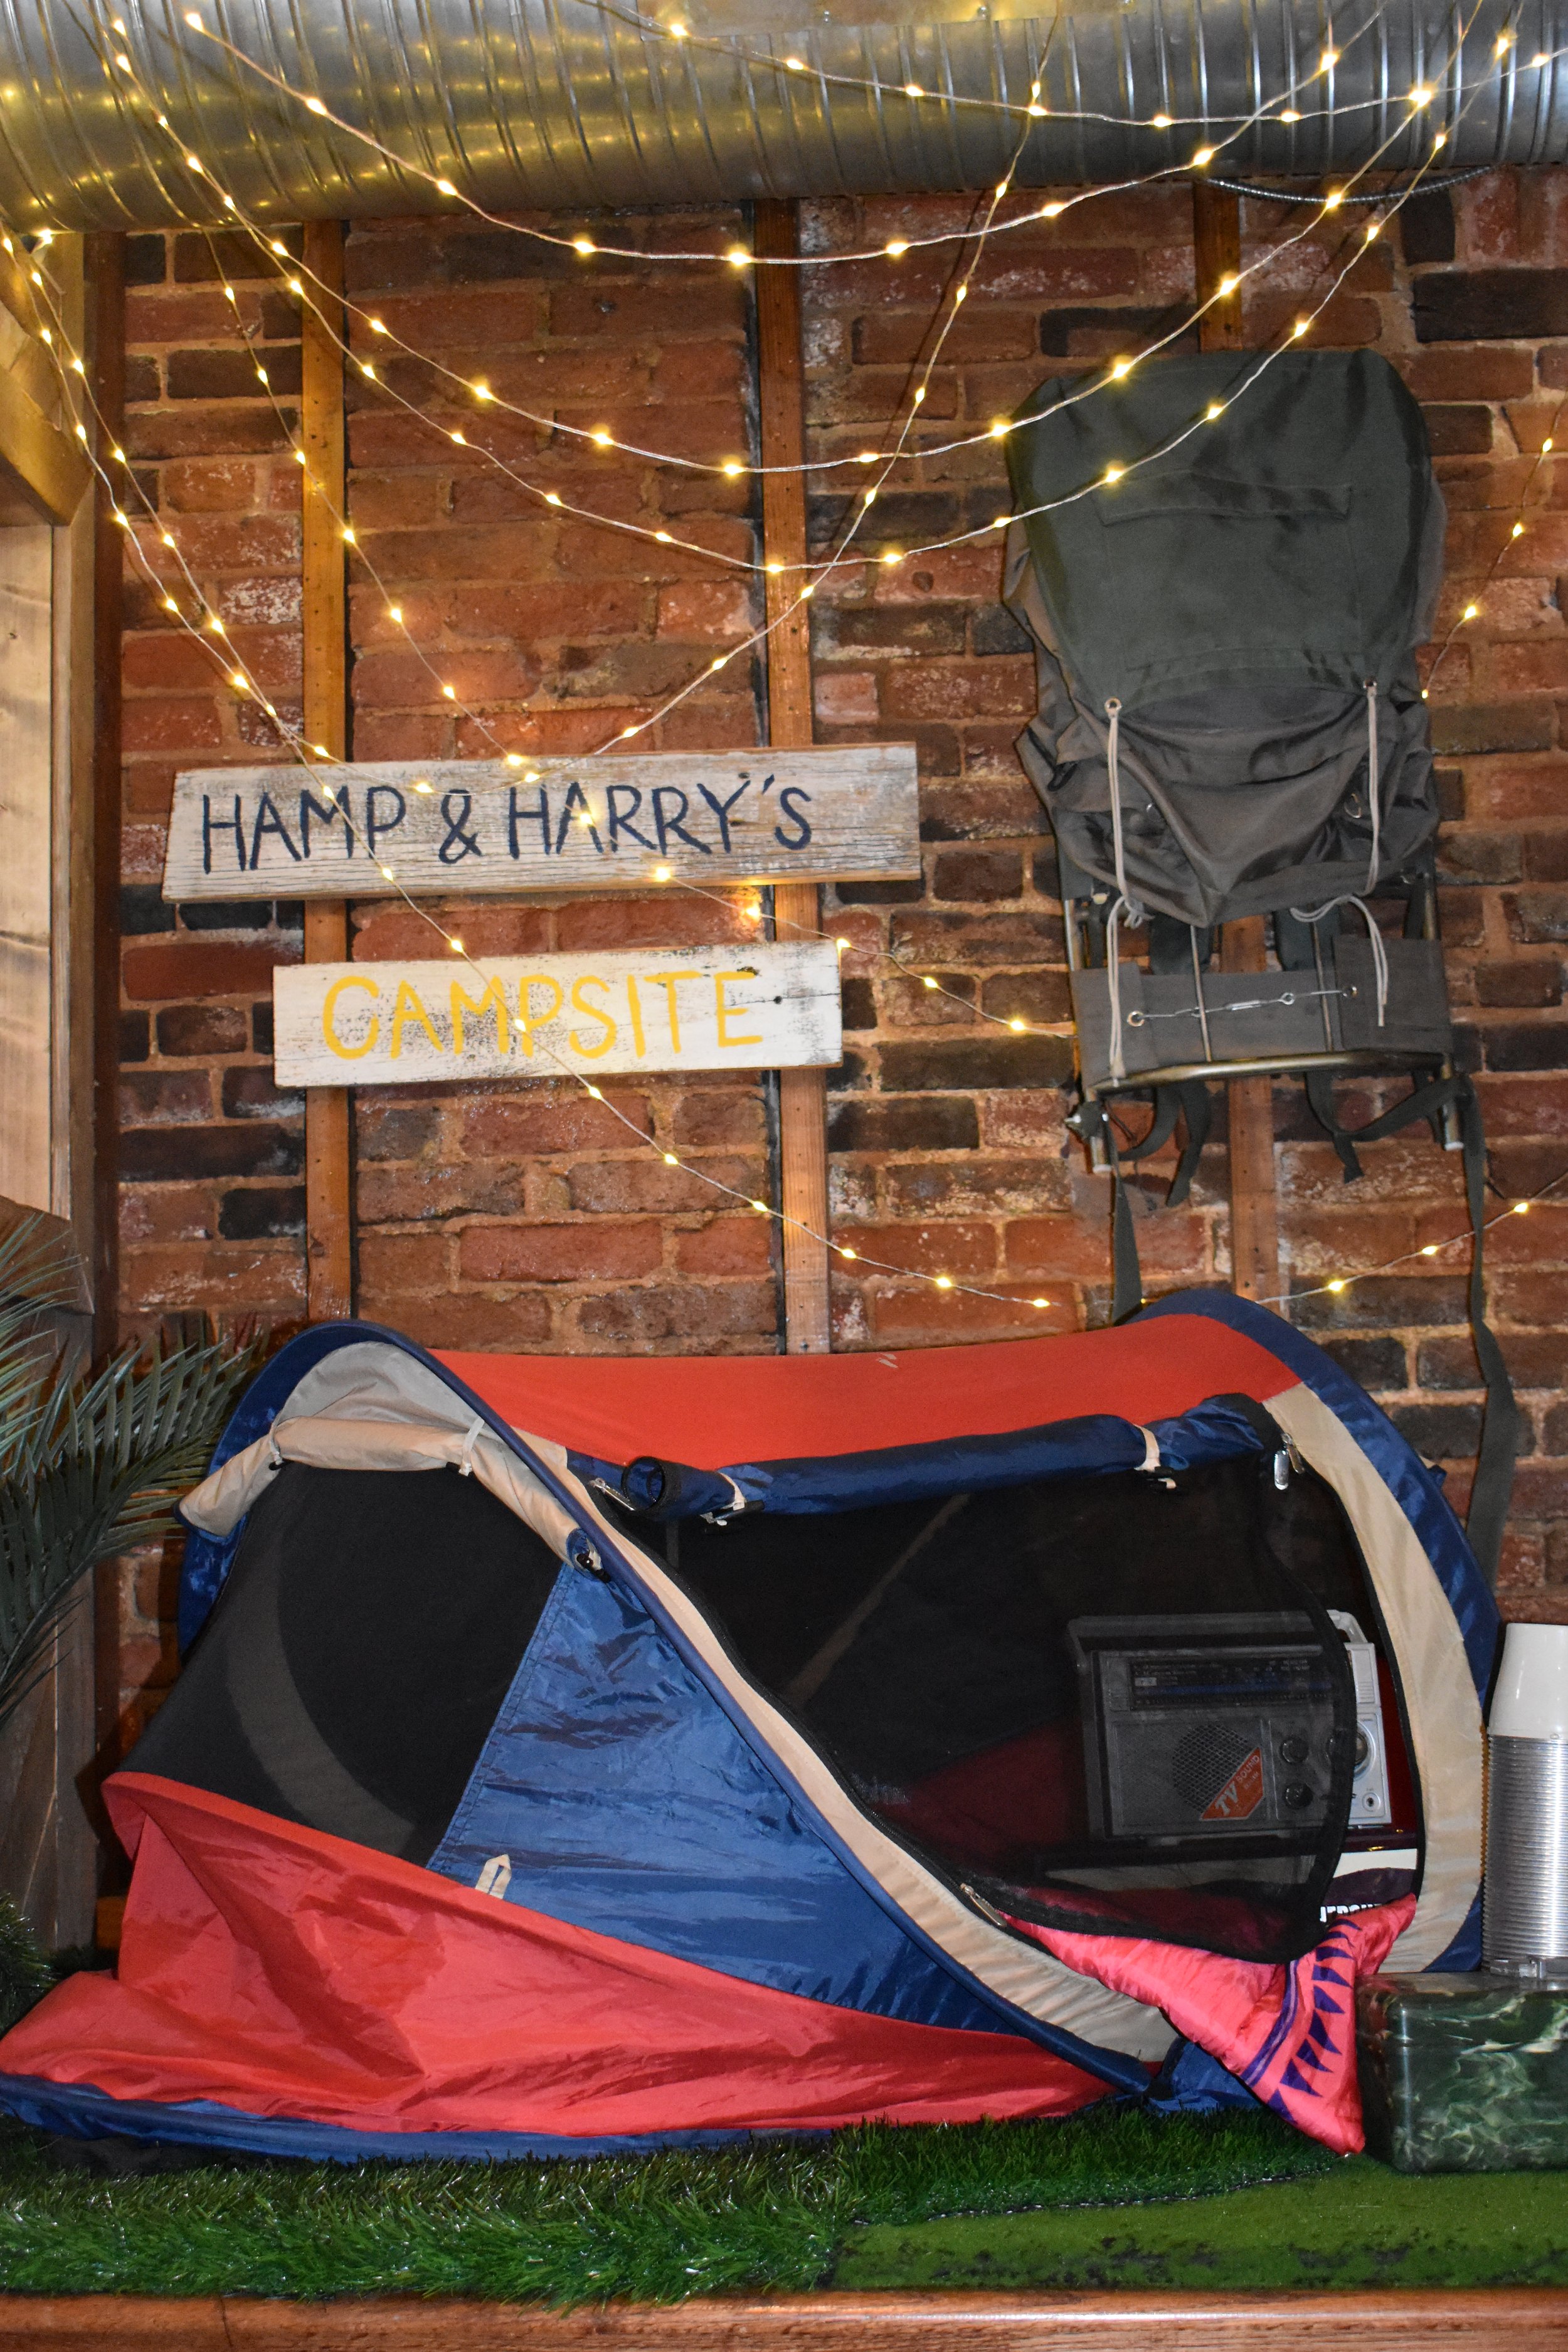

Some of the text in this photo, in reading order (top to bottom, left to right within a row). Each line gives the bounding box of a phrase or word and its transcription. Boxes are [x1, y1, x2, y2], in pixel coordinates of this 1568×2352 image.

[201, 773, 812, 874] HAMP & HARRY'S
[322, 970, 763, 1059] CAMPSITE
[1214, 1781, 1239, 1816] TV
